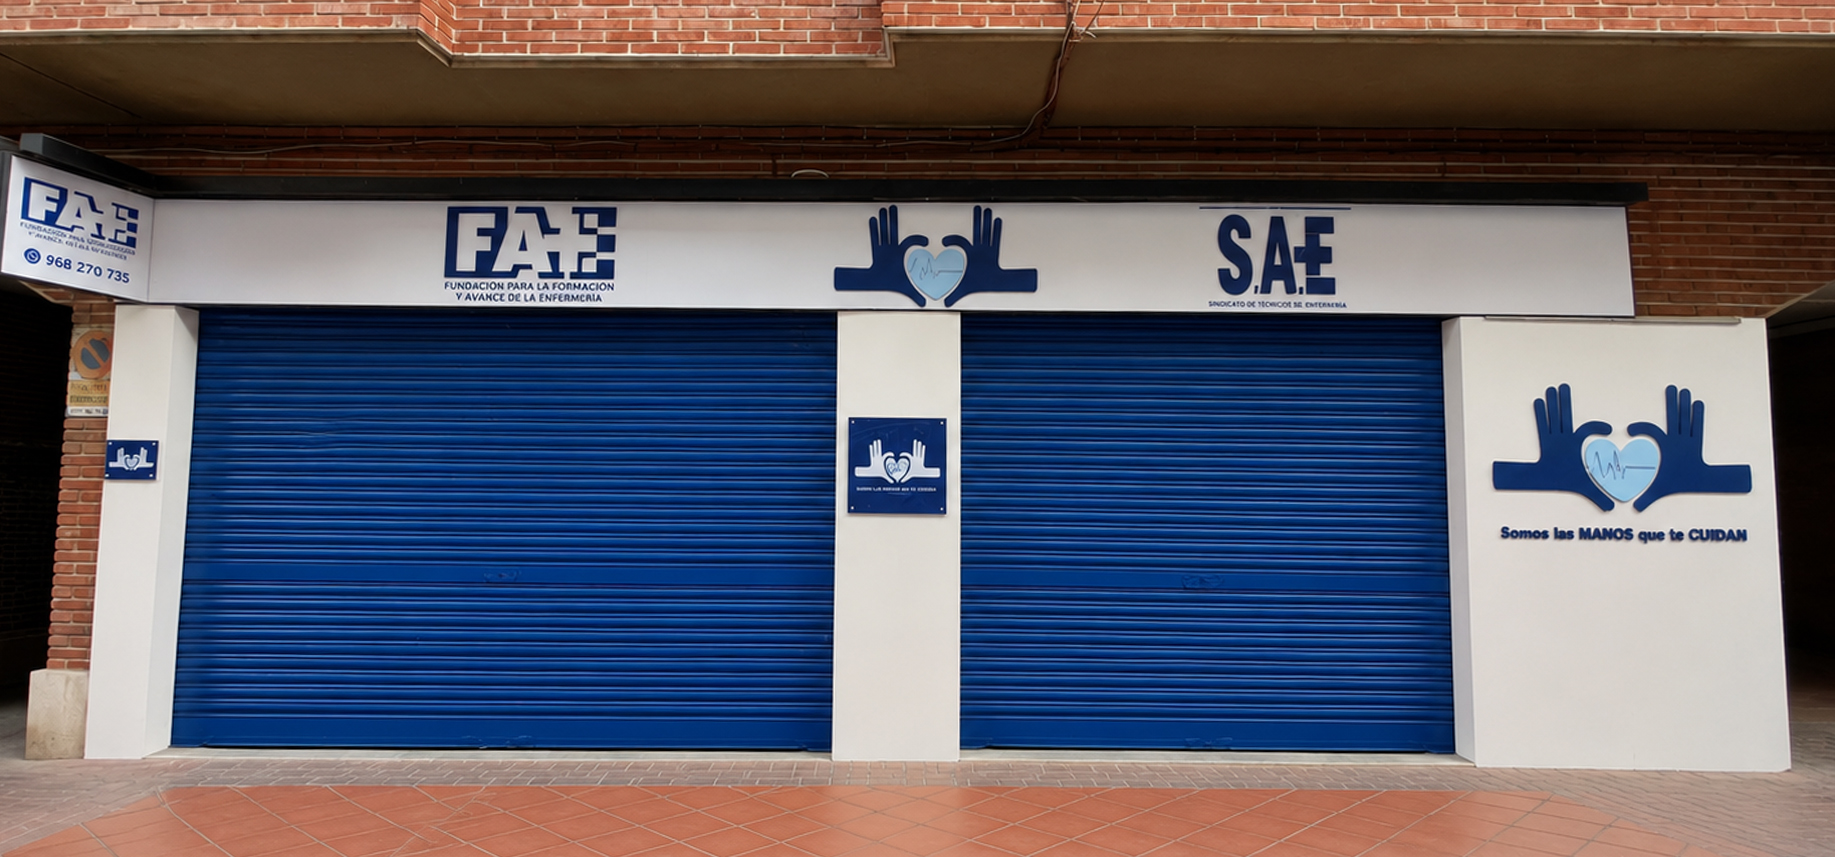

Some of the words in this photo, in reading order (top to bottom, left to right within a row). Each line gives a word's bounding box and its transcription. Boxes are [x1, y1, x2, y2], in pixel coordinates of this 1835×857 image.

[21, 176, 139, 249] FAE
[444, 206, 617, 280] FAE
[46, 254, 73, 270] 968
[76, 261, 103, 278] 270
[106, 268, 130, 284] 735
[455, 292, 463, 301] Y
[464, 292, 505, 302] AVANCE
[507, 293, 521, 302] DE
[523, 293, 536, 302] LA
[507, 282, 534, 291] PARA
[536, 282, 549, 291] LA
[1500, 526, 1550, 540] Somos
[1553, 526, 1575, 541] las
[1578, 527, 1635, 541] MANOS
[1638, 530, 1666, 544] que
[1669, 529, 1685, 541] te
[1688, 528, 1748, 542] CUIDAN
